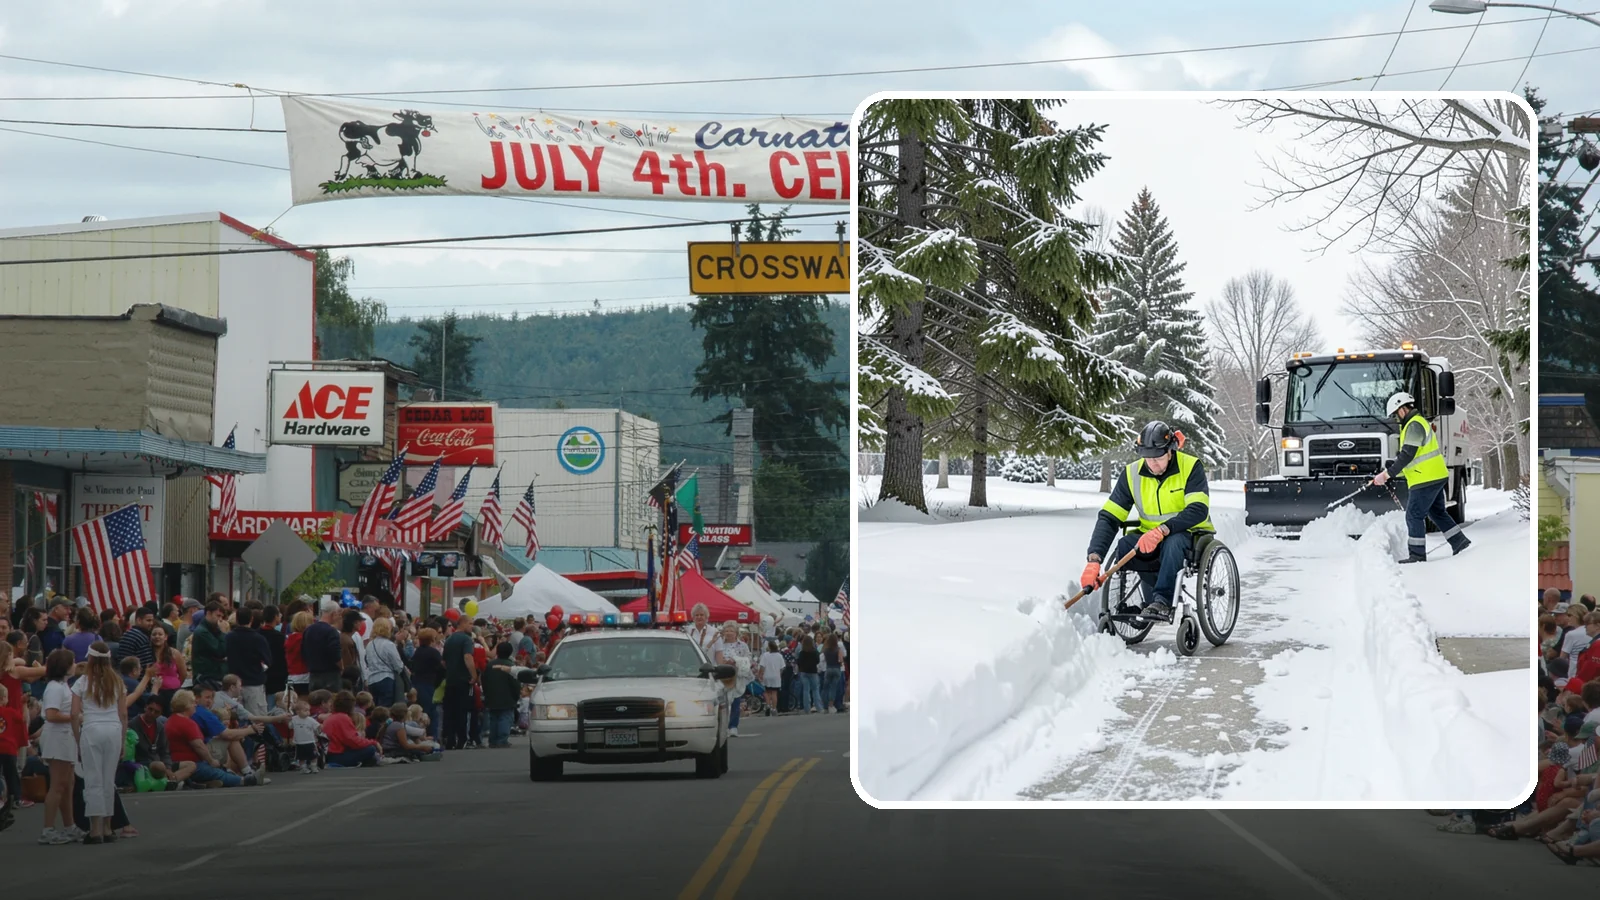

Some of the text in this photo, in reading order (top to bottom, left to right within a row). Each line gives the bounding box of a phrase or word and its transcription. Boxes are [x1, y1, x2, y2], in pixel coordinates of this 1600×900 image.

[482, 141, 604, 192] JULY
[632, 150, 746, 198] 4th.
[697, 254, 850, 279] CROSSWA
[283, 380, 373, 420] ACE
[406, 409, 452, 421] CEDAR
[284, 421, 370, 436] Hardware
[353, 467, 384, 480] Simpl
[96, 486, 123, 494] Vincent
[126, 486, 135, 494] de
[138, 486, 154, 495] Paul
